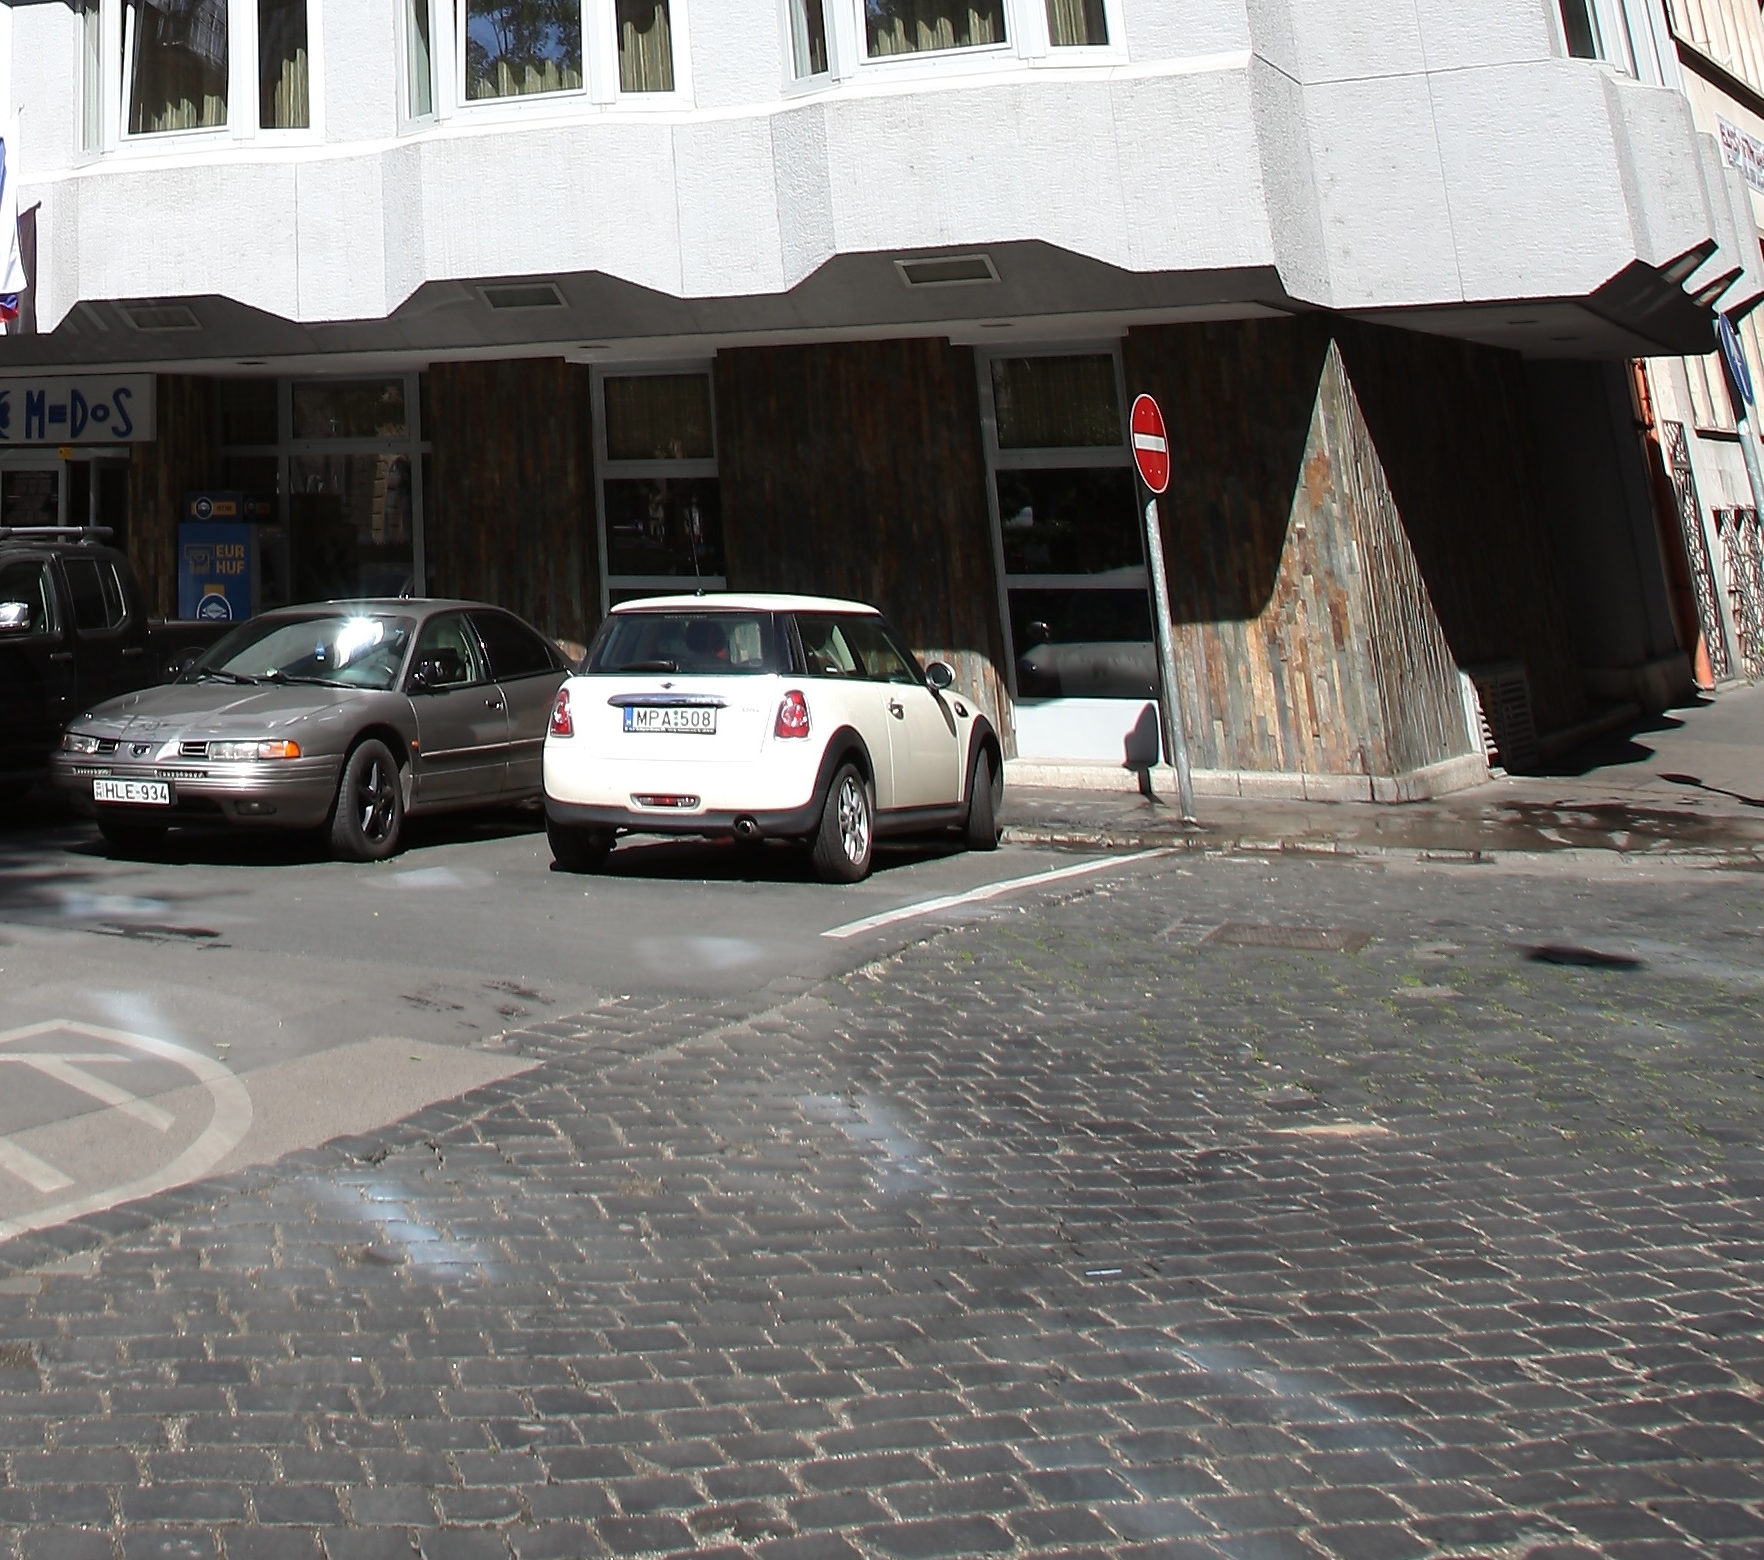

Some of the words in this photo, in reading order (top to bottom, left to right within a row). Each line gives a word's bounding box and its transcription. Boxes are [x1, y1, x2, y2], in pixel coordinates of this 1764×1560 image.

[216, 544, 245, 557] EUR
[216, 561, 245, 574] HUF
[105, 782, 168, 802] HLE-934
